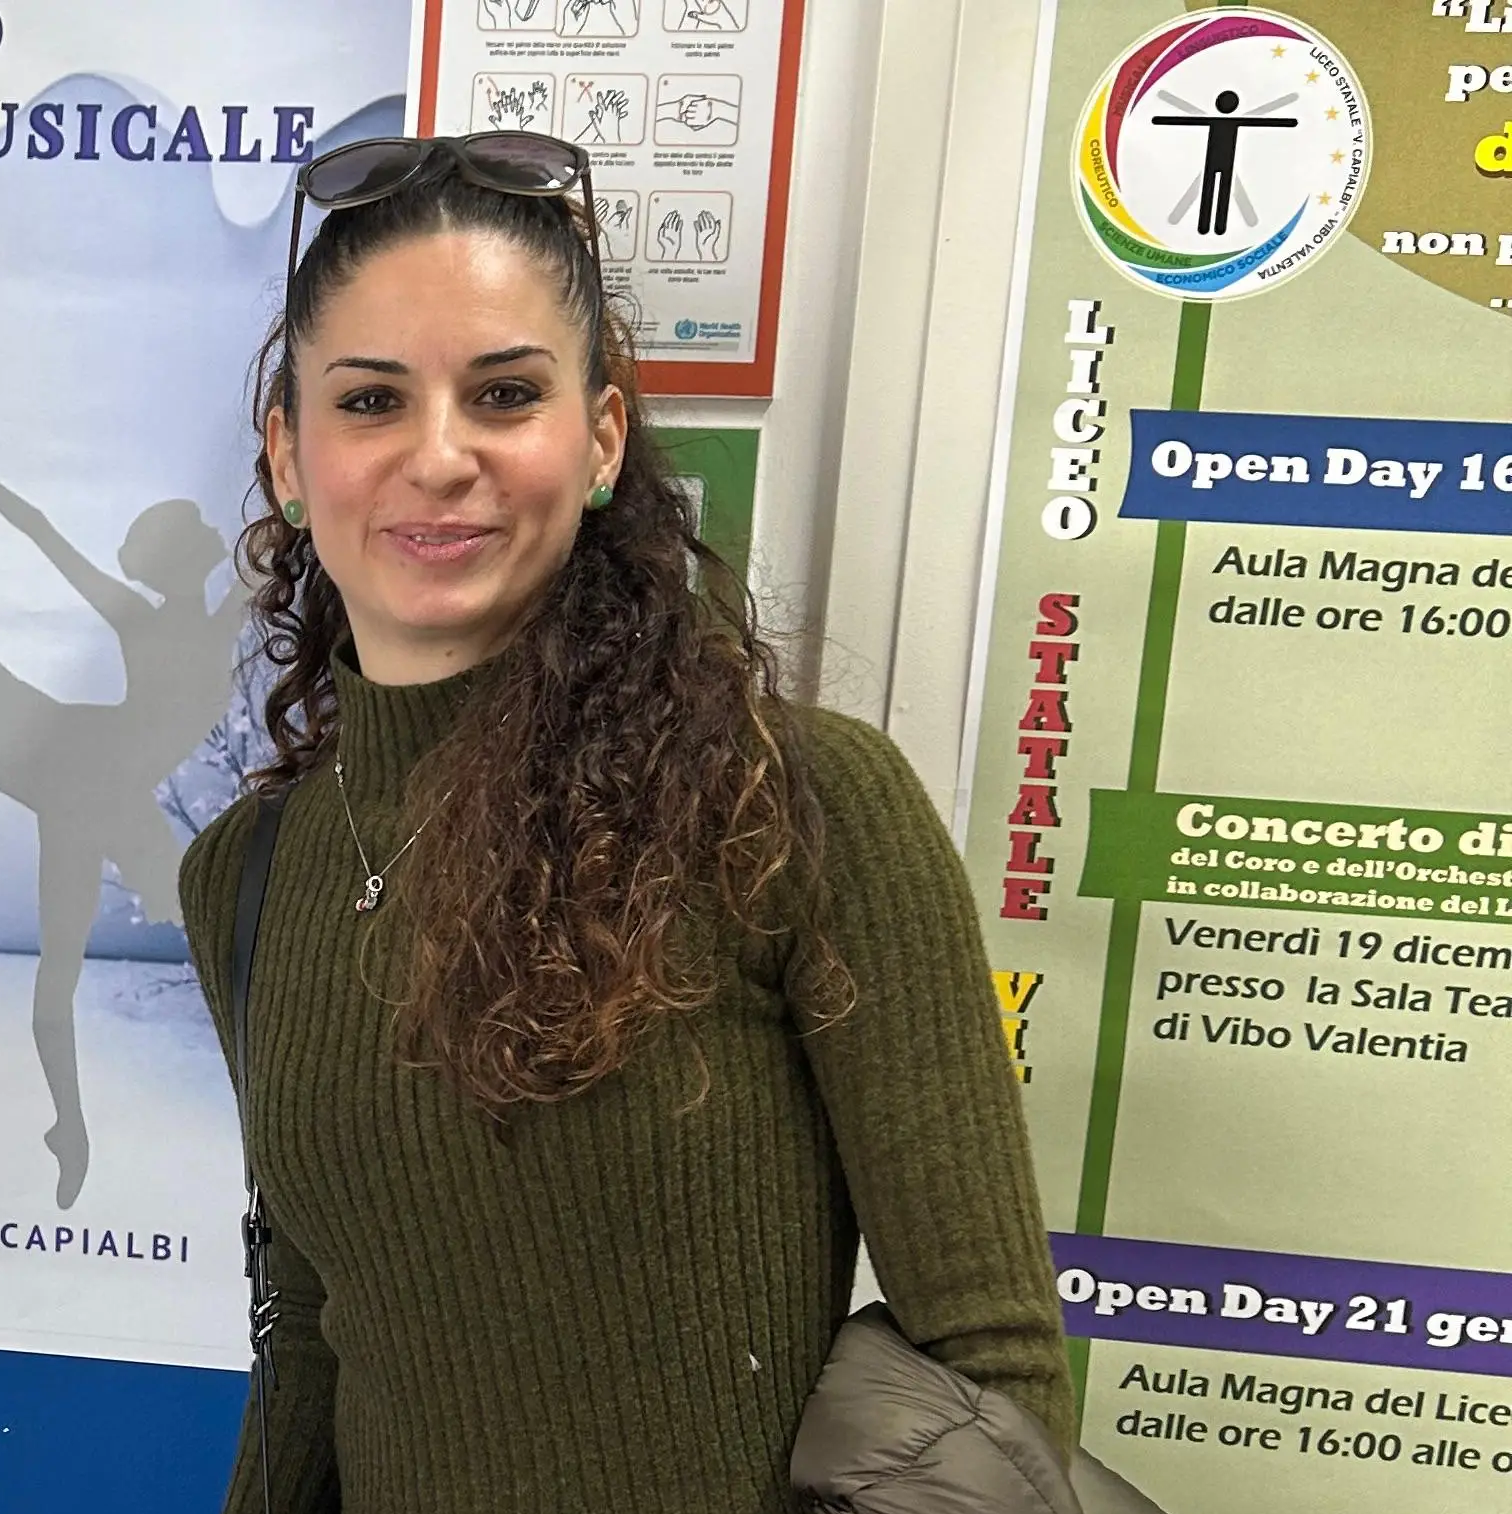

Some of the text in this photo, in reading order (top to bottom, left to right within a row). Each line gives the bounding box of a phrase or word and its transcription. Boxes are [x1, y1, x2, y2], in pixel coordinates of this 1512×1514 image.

[1309, 47, 1340, 77] LICEO
[1335, 77, 1362, 128] STATALE
[1089, 139, 1119, 208] COREUTICO
[1099, 221, 1193, 268] SCIENZE UMANE
[1312, 219, 1338, 244] VIBO
[1381, 231, 1486, 256] non
[1156, 230, 1288, 285] ECONOMICO SOCIALE
[1257, 243, 1314, 280] VALENTIA
[1041, 300, 1113, 540] LICEO
[1151, 440, 1310, 489] Open
[1323, 448, 1443, 499] Day
[1212, 545, 1309, 579] Aula
[1319, 550, 1460, 592] Magna
[1208, 595, 1511, 638] dalle ore 16:00
[999, 593, 1080, 921] STATALE
[1176, 803, 1445, 853] Concerto
[1170, 848, 1219, 868] del
[1224, 850, 1297, 874] Coro
[1302, 860, 1321, 874] e
[1166, 875, 1197, 895] in
[1203, 880, 1434, 912] collaborazione
[1440, 895, 1489, 916] del
[1165, 917, 1512, 970] Venerdì 19 dicem
[1156, 969, 1285, 1001] presso
[1306, 976, 1341, 1005] la
[1351, 979, 1433, 1013] Sala
[1153, 1012, 1469, 1062] di Vibo Valentia
[1056, 1268, 1208, 1316] Open
[1220, 1283, 1335, 1335] Day
[1345, 1295, 1409, 1334] 21
[1119, 1364, 1210, 1398] Aula
[1220, 1373, 1355, 1415] Magna
[1364, 1388, 1425, 1418] del
[1116, 1410, 1209, 1443] dalle
[1218, 1424, 1282, 1450] ore
[1298, 1426, 1402, 1462] 16:00
[1411, 1439, 1482, 1470] alle
